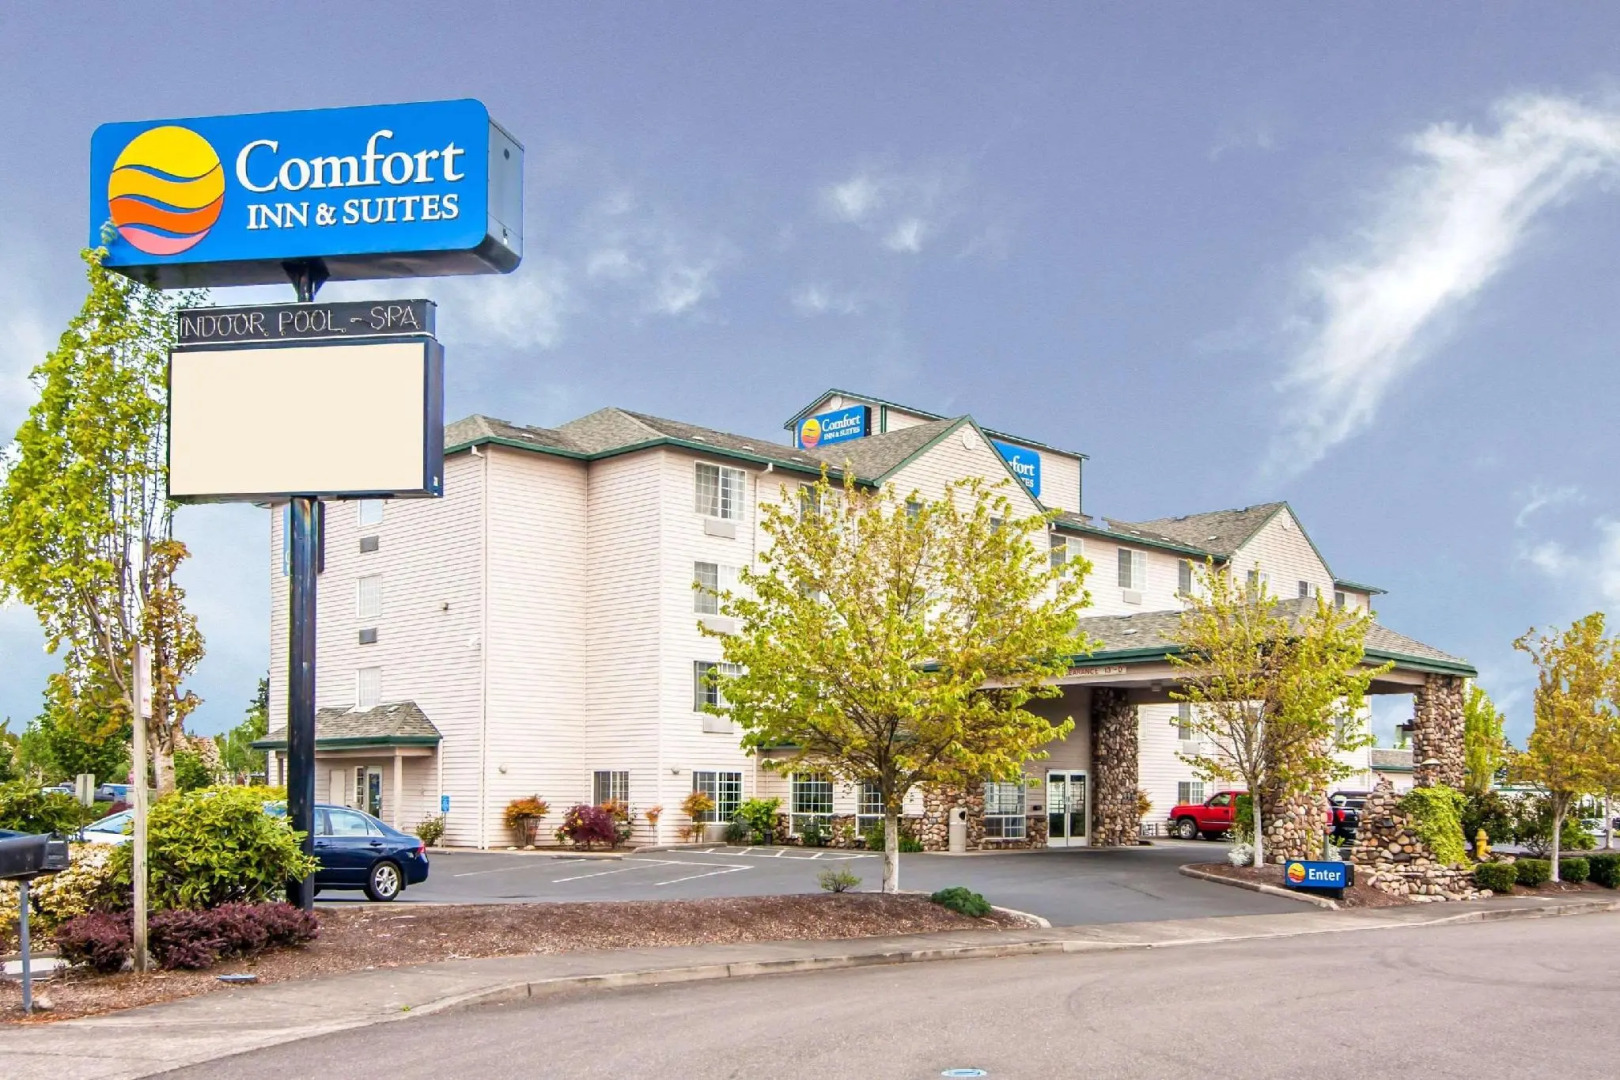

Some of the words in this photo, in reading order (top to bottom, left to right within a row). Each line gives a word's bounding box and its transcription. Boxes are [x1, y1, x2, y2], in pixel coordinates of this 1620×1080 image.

[235, 129, 465, 193] Comfort
[247, 202, 310, 230] INN
[315, 203, 337, 227] &
[342, 194, 460, 225] SUITES
[180, 312, 267, 338] INDOOR
[278, 309, 345, 334] POOL
[370, 305, 418, 331] SPA
[822, 413, 861, 432] Comfort
[823, 432, 835, 441] INN
[840, 426, 861, 437] SUITES
[1008, 455, 1035, 477] fort
[1068, 667, 1099, 676] EARANCE
[1308, 868, 1341, 881] Enter
